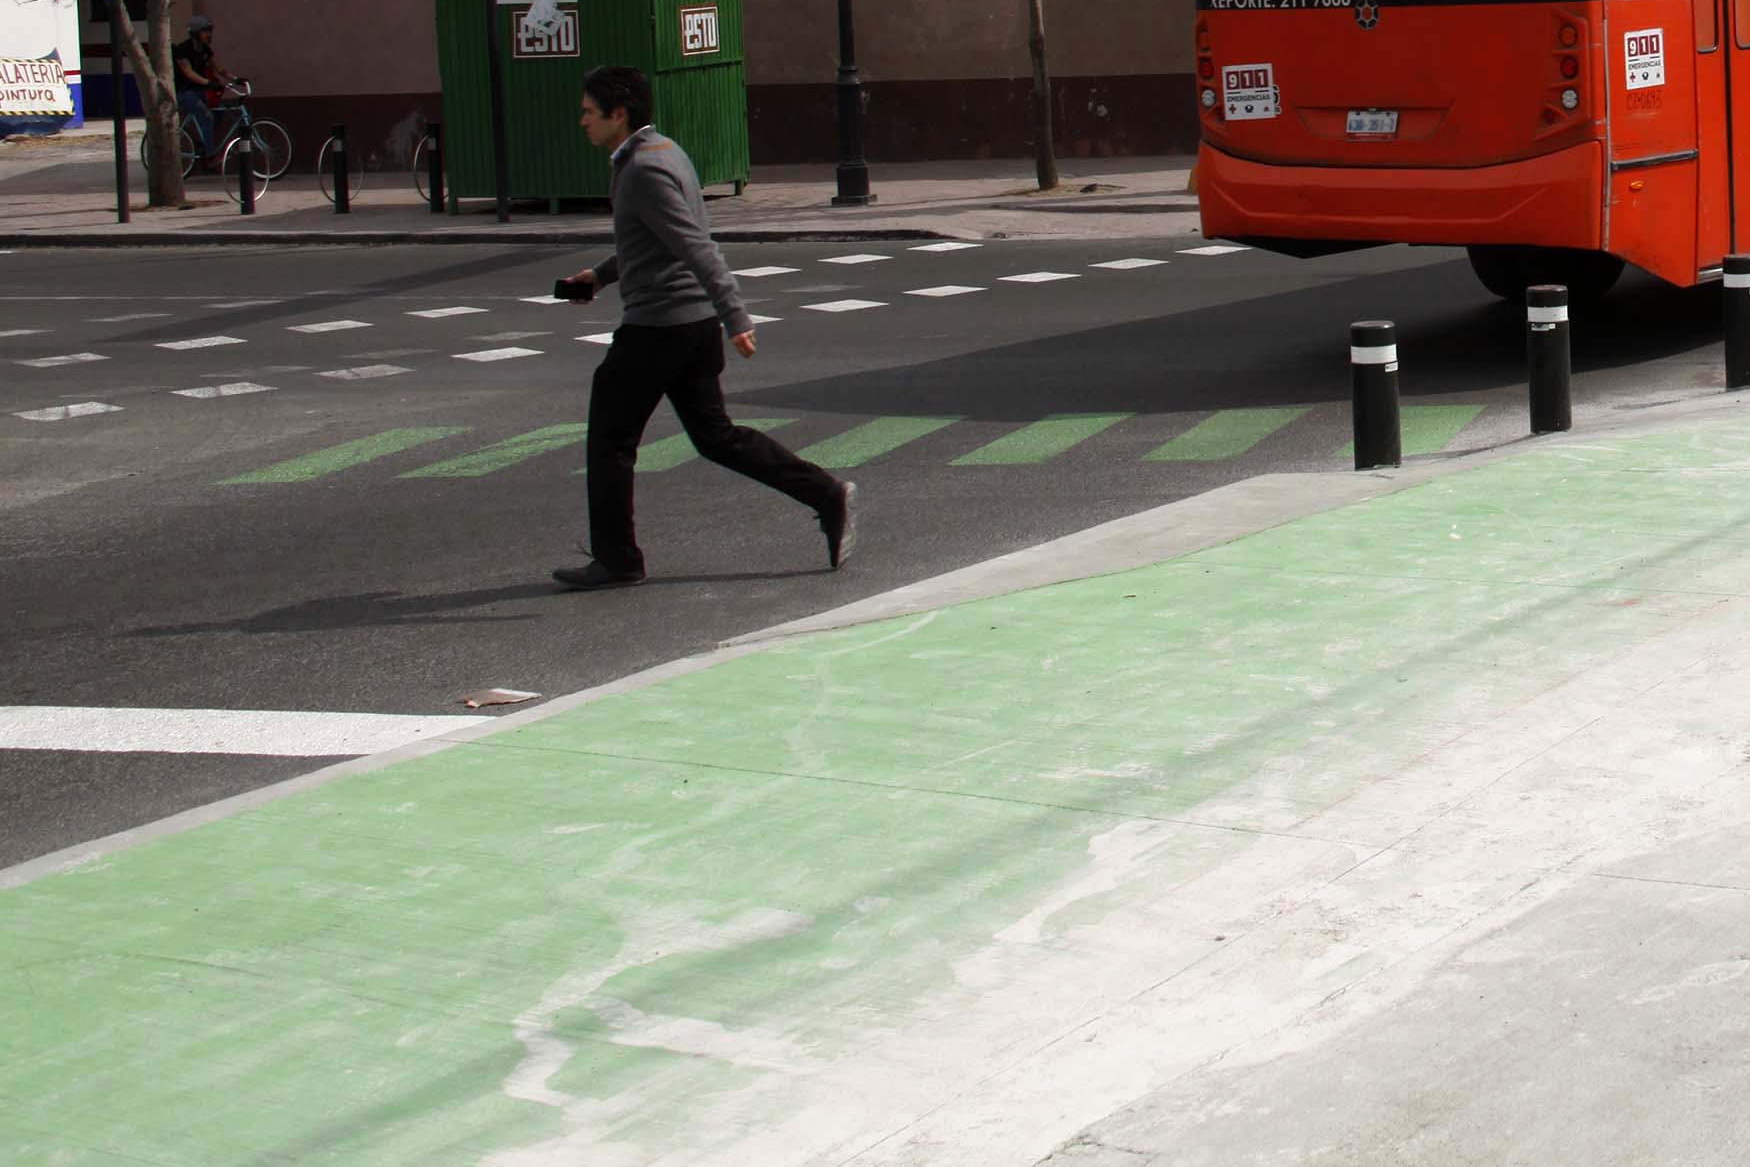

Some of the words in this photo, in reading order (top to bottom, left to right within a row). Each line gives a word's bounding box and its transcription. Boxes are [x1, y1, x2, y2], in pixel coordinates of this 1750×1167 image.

[1628, 36, 1658, 55] 911
[1628, 60, 1662, 71] EMERGENCIAS
[1228, 71, 1266, 89] 911
